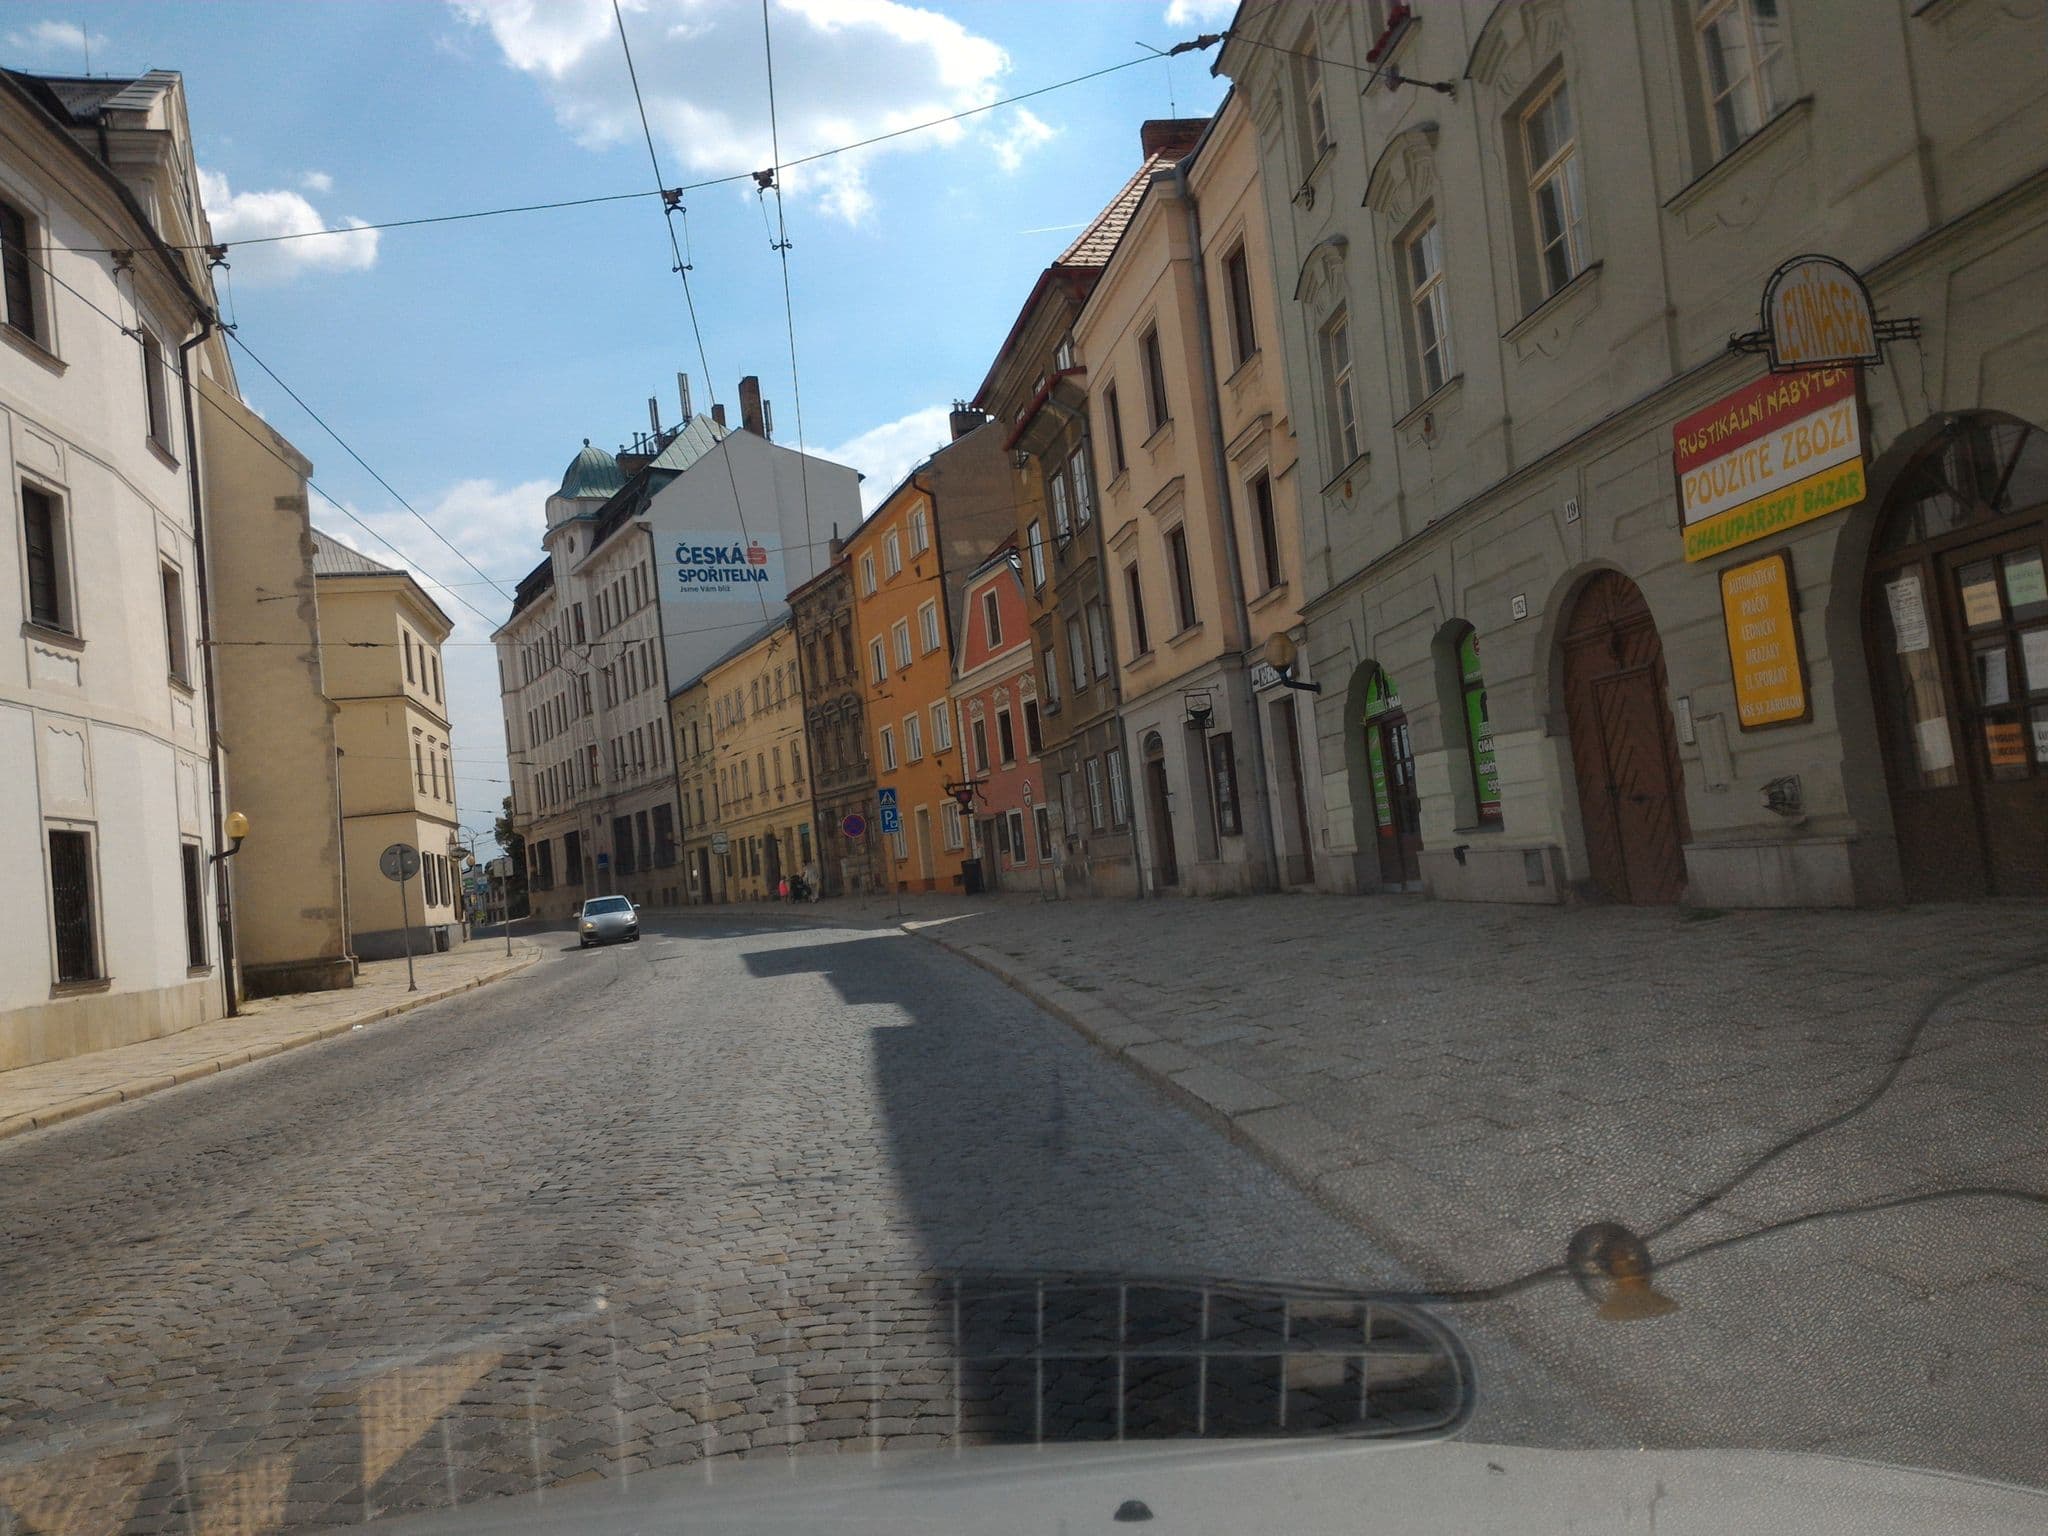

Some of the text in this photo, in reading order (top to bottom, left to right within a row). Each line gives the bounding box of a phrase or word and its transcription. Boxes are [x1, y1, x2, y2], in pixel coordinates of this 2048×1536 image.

[1679, 394, 1764, 459] RUSTIKÁLNÍ
[1685, 404, 1856, 509] POUŽITÉ ZBOŽÍ
[1803, 470, 1861, 513] BAZAR
[676, 542, 745, 565] ČESKÁ
[678, 566, 768, 582] SPOŘITELNA
